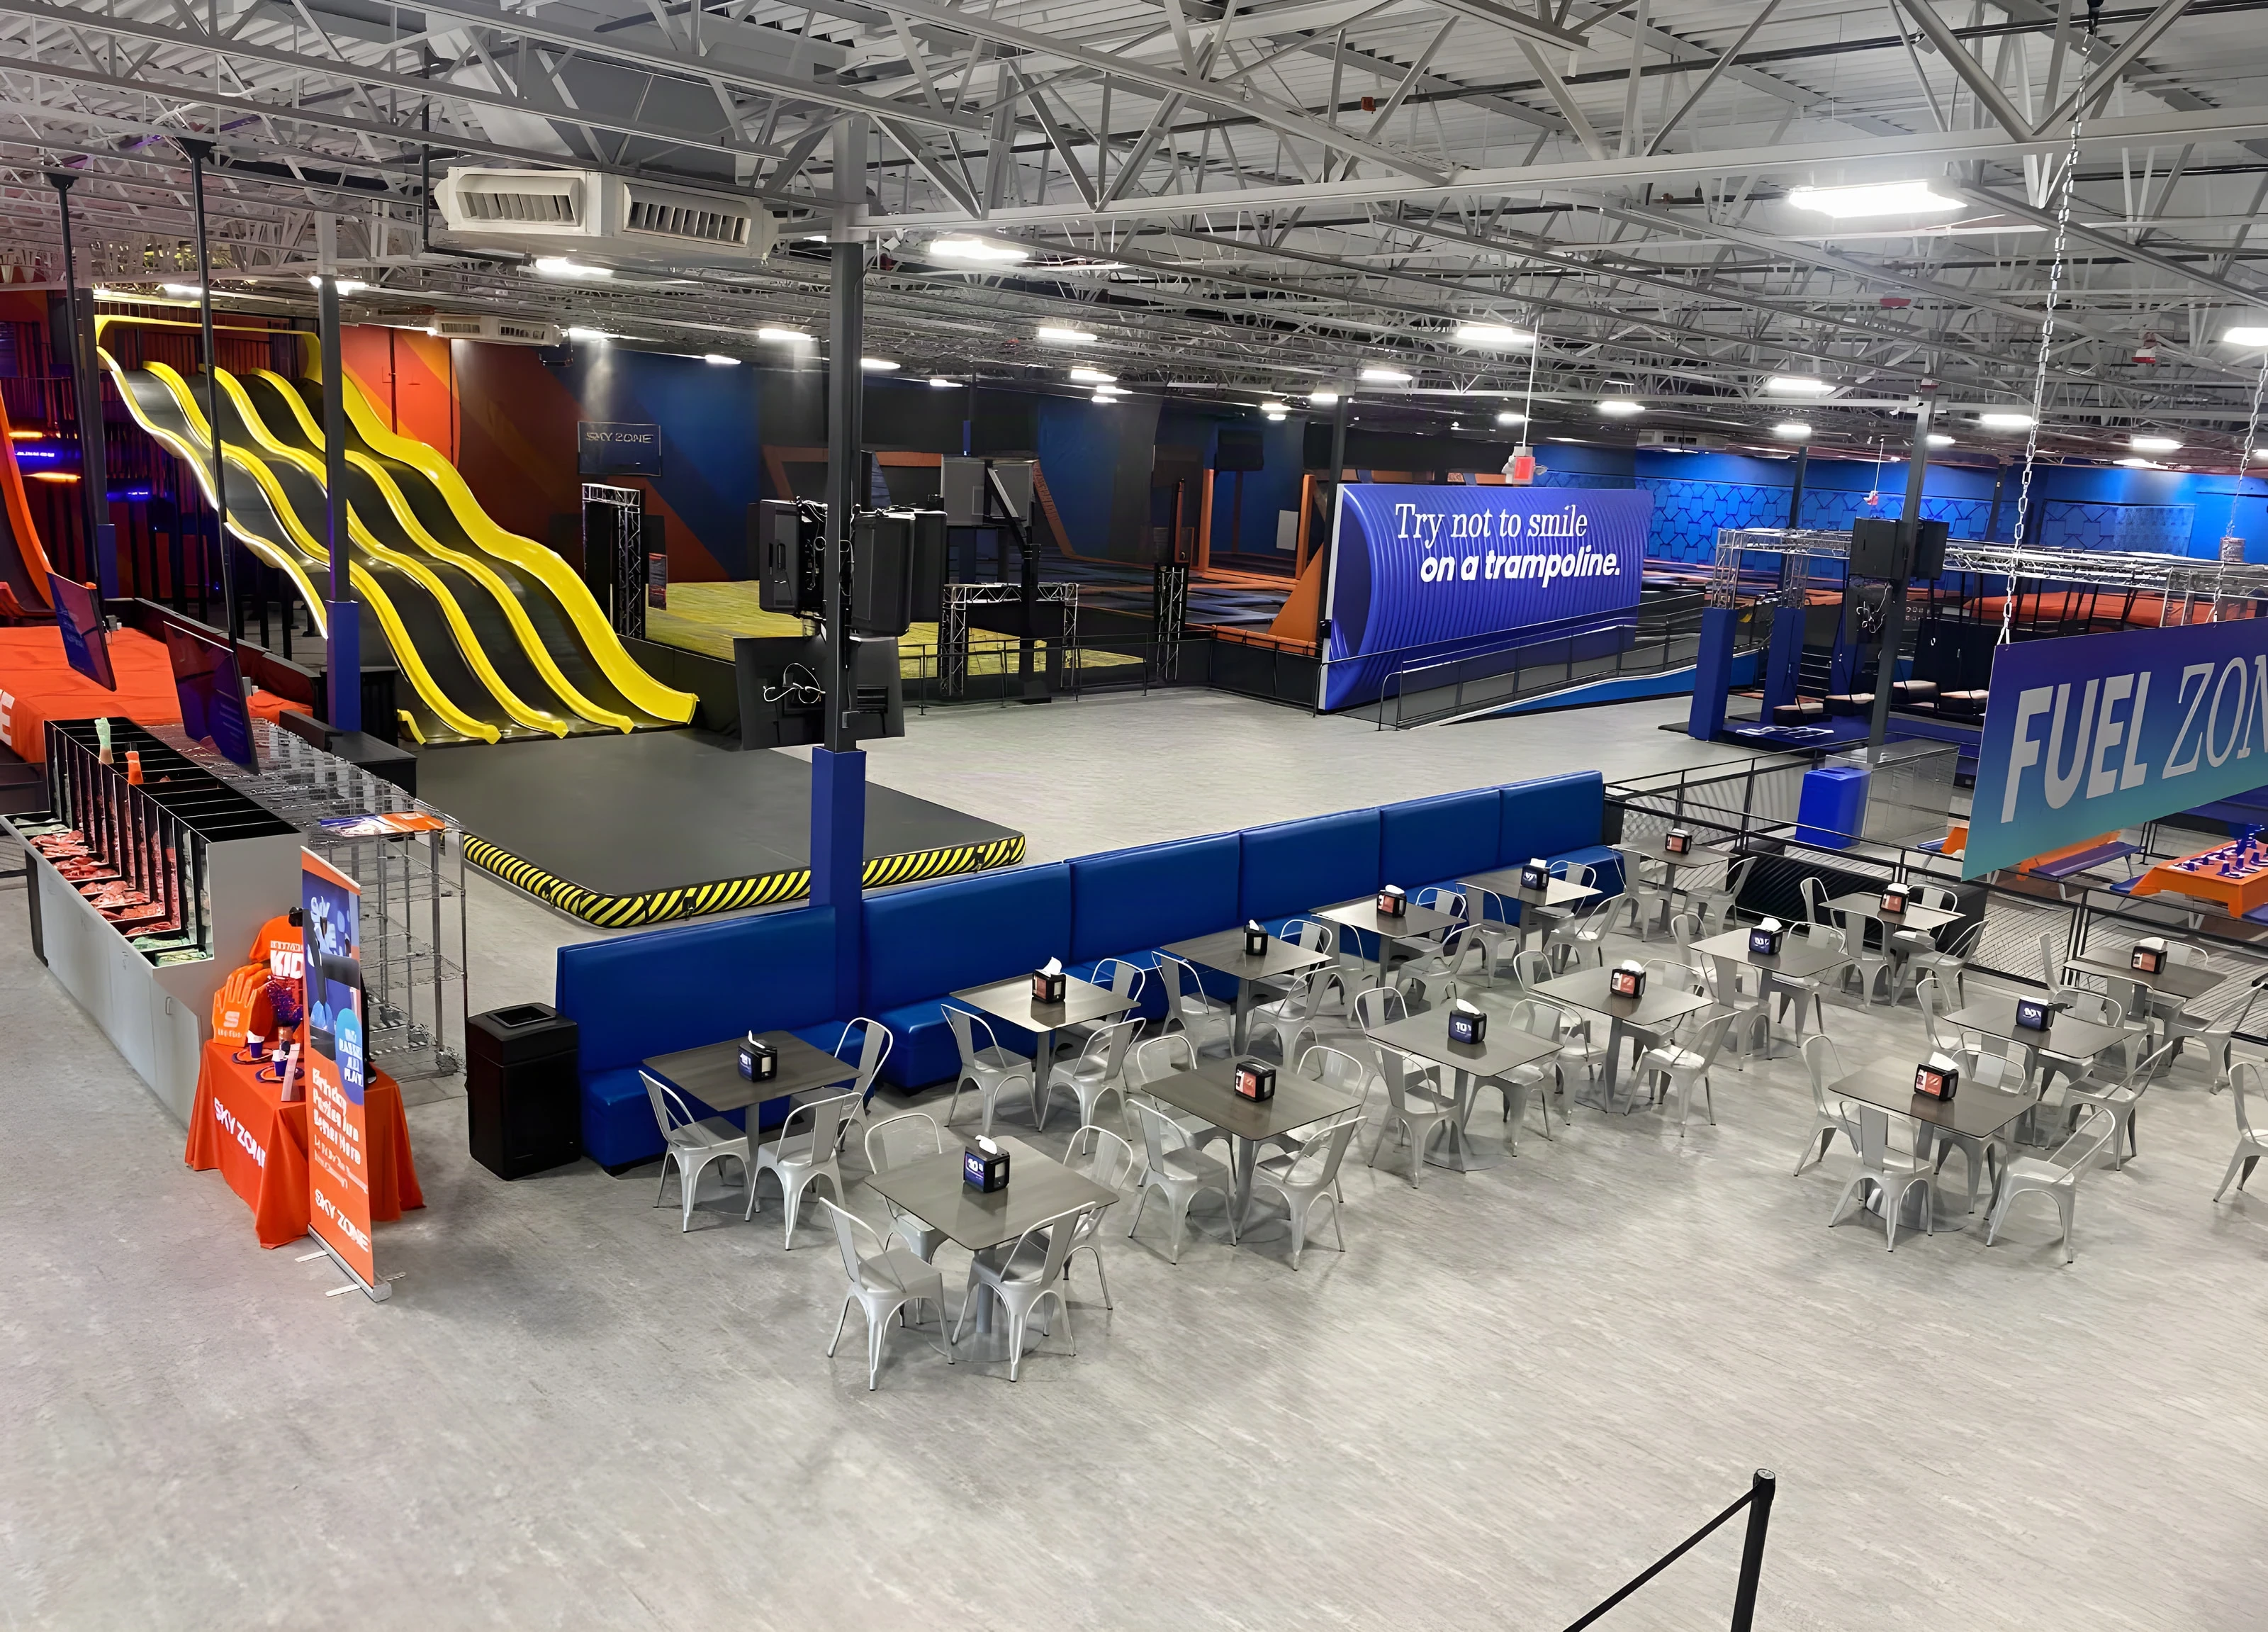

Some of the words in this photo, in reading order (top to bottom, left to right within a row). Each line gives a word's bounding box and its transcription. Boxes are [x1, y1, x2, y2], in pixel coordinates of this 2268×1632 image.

[586, 432, 613, 441] SKY
[614, 432, 653, 443] ZONE
[1395, 503, 1445, 549] Try
[1450, 508, 1493, 538] not
[1499, 508, 1522, 537] to
[1527, 504, 1588, 537] smile
[1420, 556, 1456, 583] on
[1461, 555, 1480, 581] a
[1485, 544, 1621, 588] trampoline.
[2001, 671, 2152, 824] FUEL
[315, 1188, 336, 1219] SKY
[337, 1208, 369, 1253] ZONE
